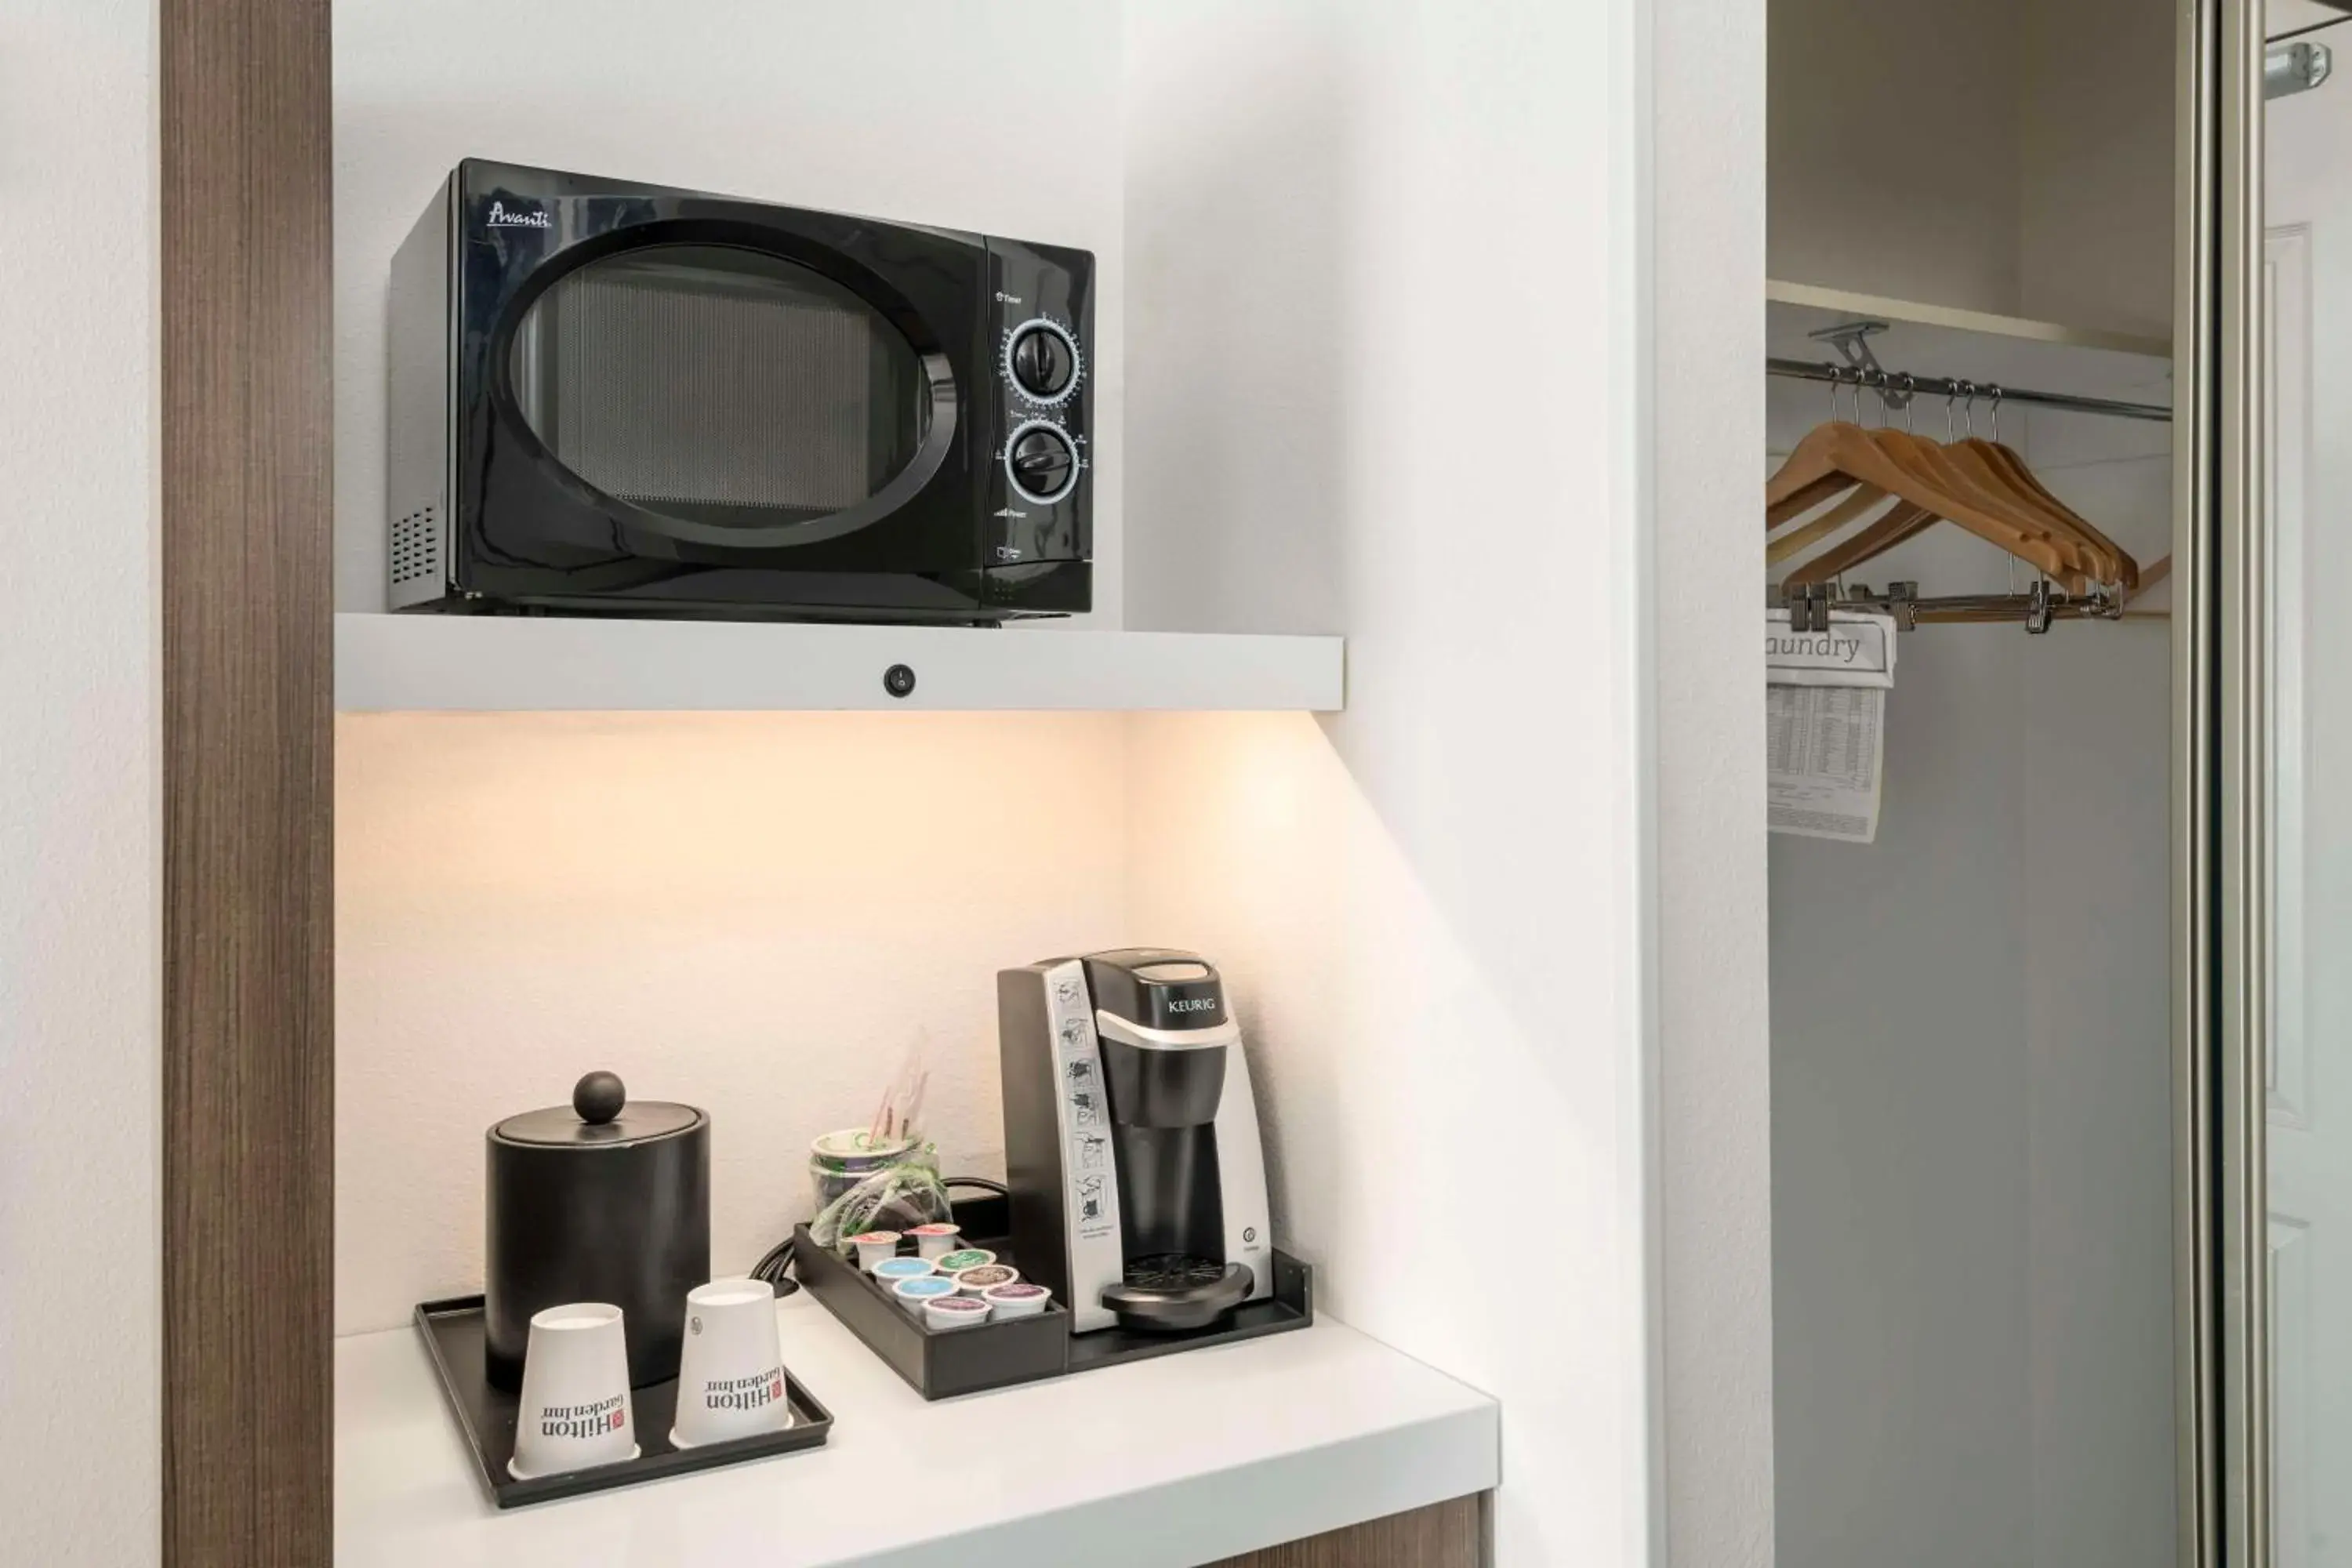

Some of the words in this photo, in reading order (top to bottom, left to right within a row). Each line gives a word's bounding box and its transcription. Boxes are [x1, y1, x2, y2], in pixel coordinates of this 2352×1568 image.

[488, 201, 550, 227] Avanti
[1168, 998, 1215, 1013] KEURIG
[706, 1380, 733, 1393] Inn
[737, 1367, 780, 1389] Garden
[574, 1394, 623, 1416] Garden
[706, 1385, 771, 1410] Hilton
[543, 1406, 571, 1421] Inn
[542, 1414, 612, 1439] Hilton
